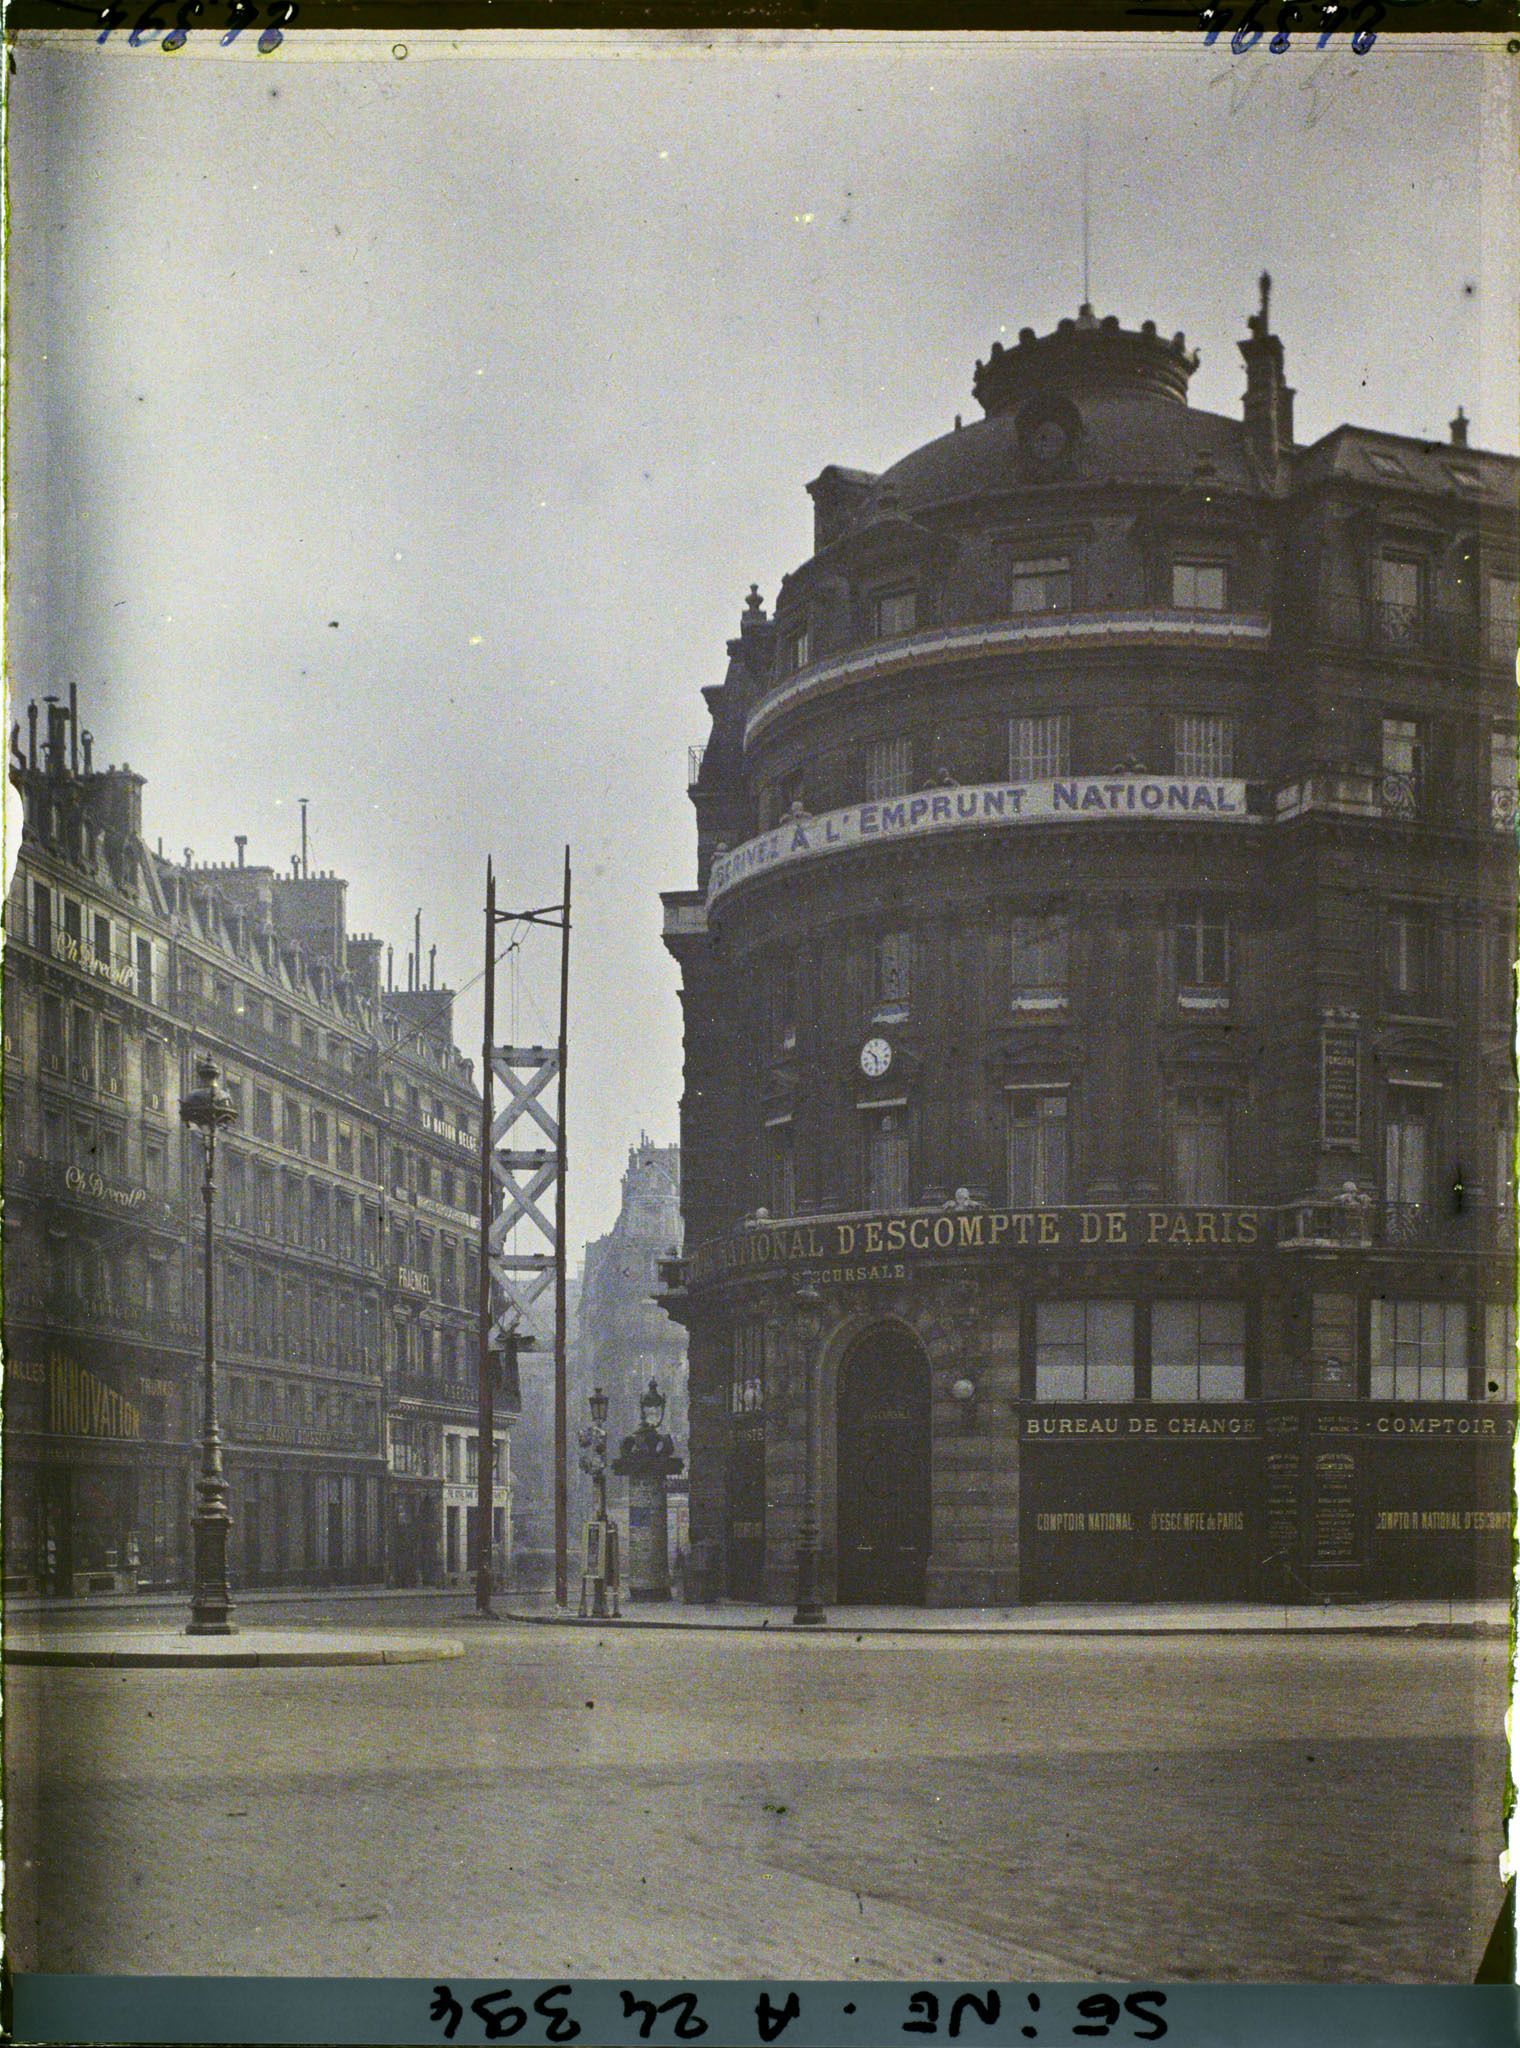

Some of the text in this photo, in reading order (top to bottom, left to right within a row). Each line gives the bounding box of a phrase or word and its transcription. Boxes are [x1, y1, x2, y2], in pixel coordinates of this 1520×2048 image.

[825, 789, 1027, 841] L'EMPRUNT
[1051, 782, 1236, 812] NATIONAL
[422, 1112, 431, 1128] LA
[433, 1117, 457, 1142] NATION
[837, 1213, 1061, 1255] D'ESCOMPTE
[1081, 1213, 1128, 1243] DE
[1147, 1212, 1260, 1244] PARIS
[50, 1351, 140, 1438] INNOVATION
[1026, 1418, 1118, 1434] BUREAU
[1129, 1418, 1158, 1433] DE
[1167, 1418, 1256, 1434] CHANGE
[1377, 1417, 1496, 1433] COMPTOIR
[1037, 1512, 1083, 1531] COMPTOIR
[1088, 1512, 1133, 1531] NATIONAL
[1217, 1511, 1244, 1531] PARIS
[1376, 1511, 1419, 1530] COMPTOR
[1421, 1511, 1461, 1530] NATIONAL
[619, 1989, 709, 2040] 24
[754, 1991, 801, 2043] A
